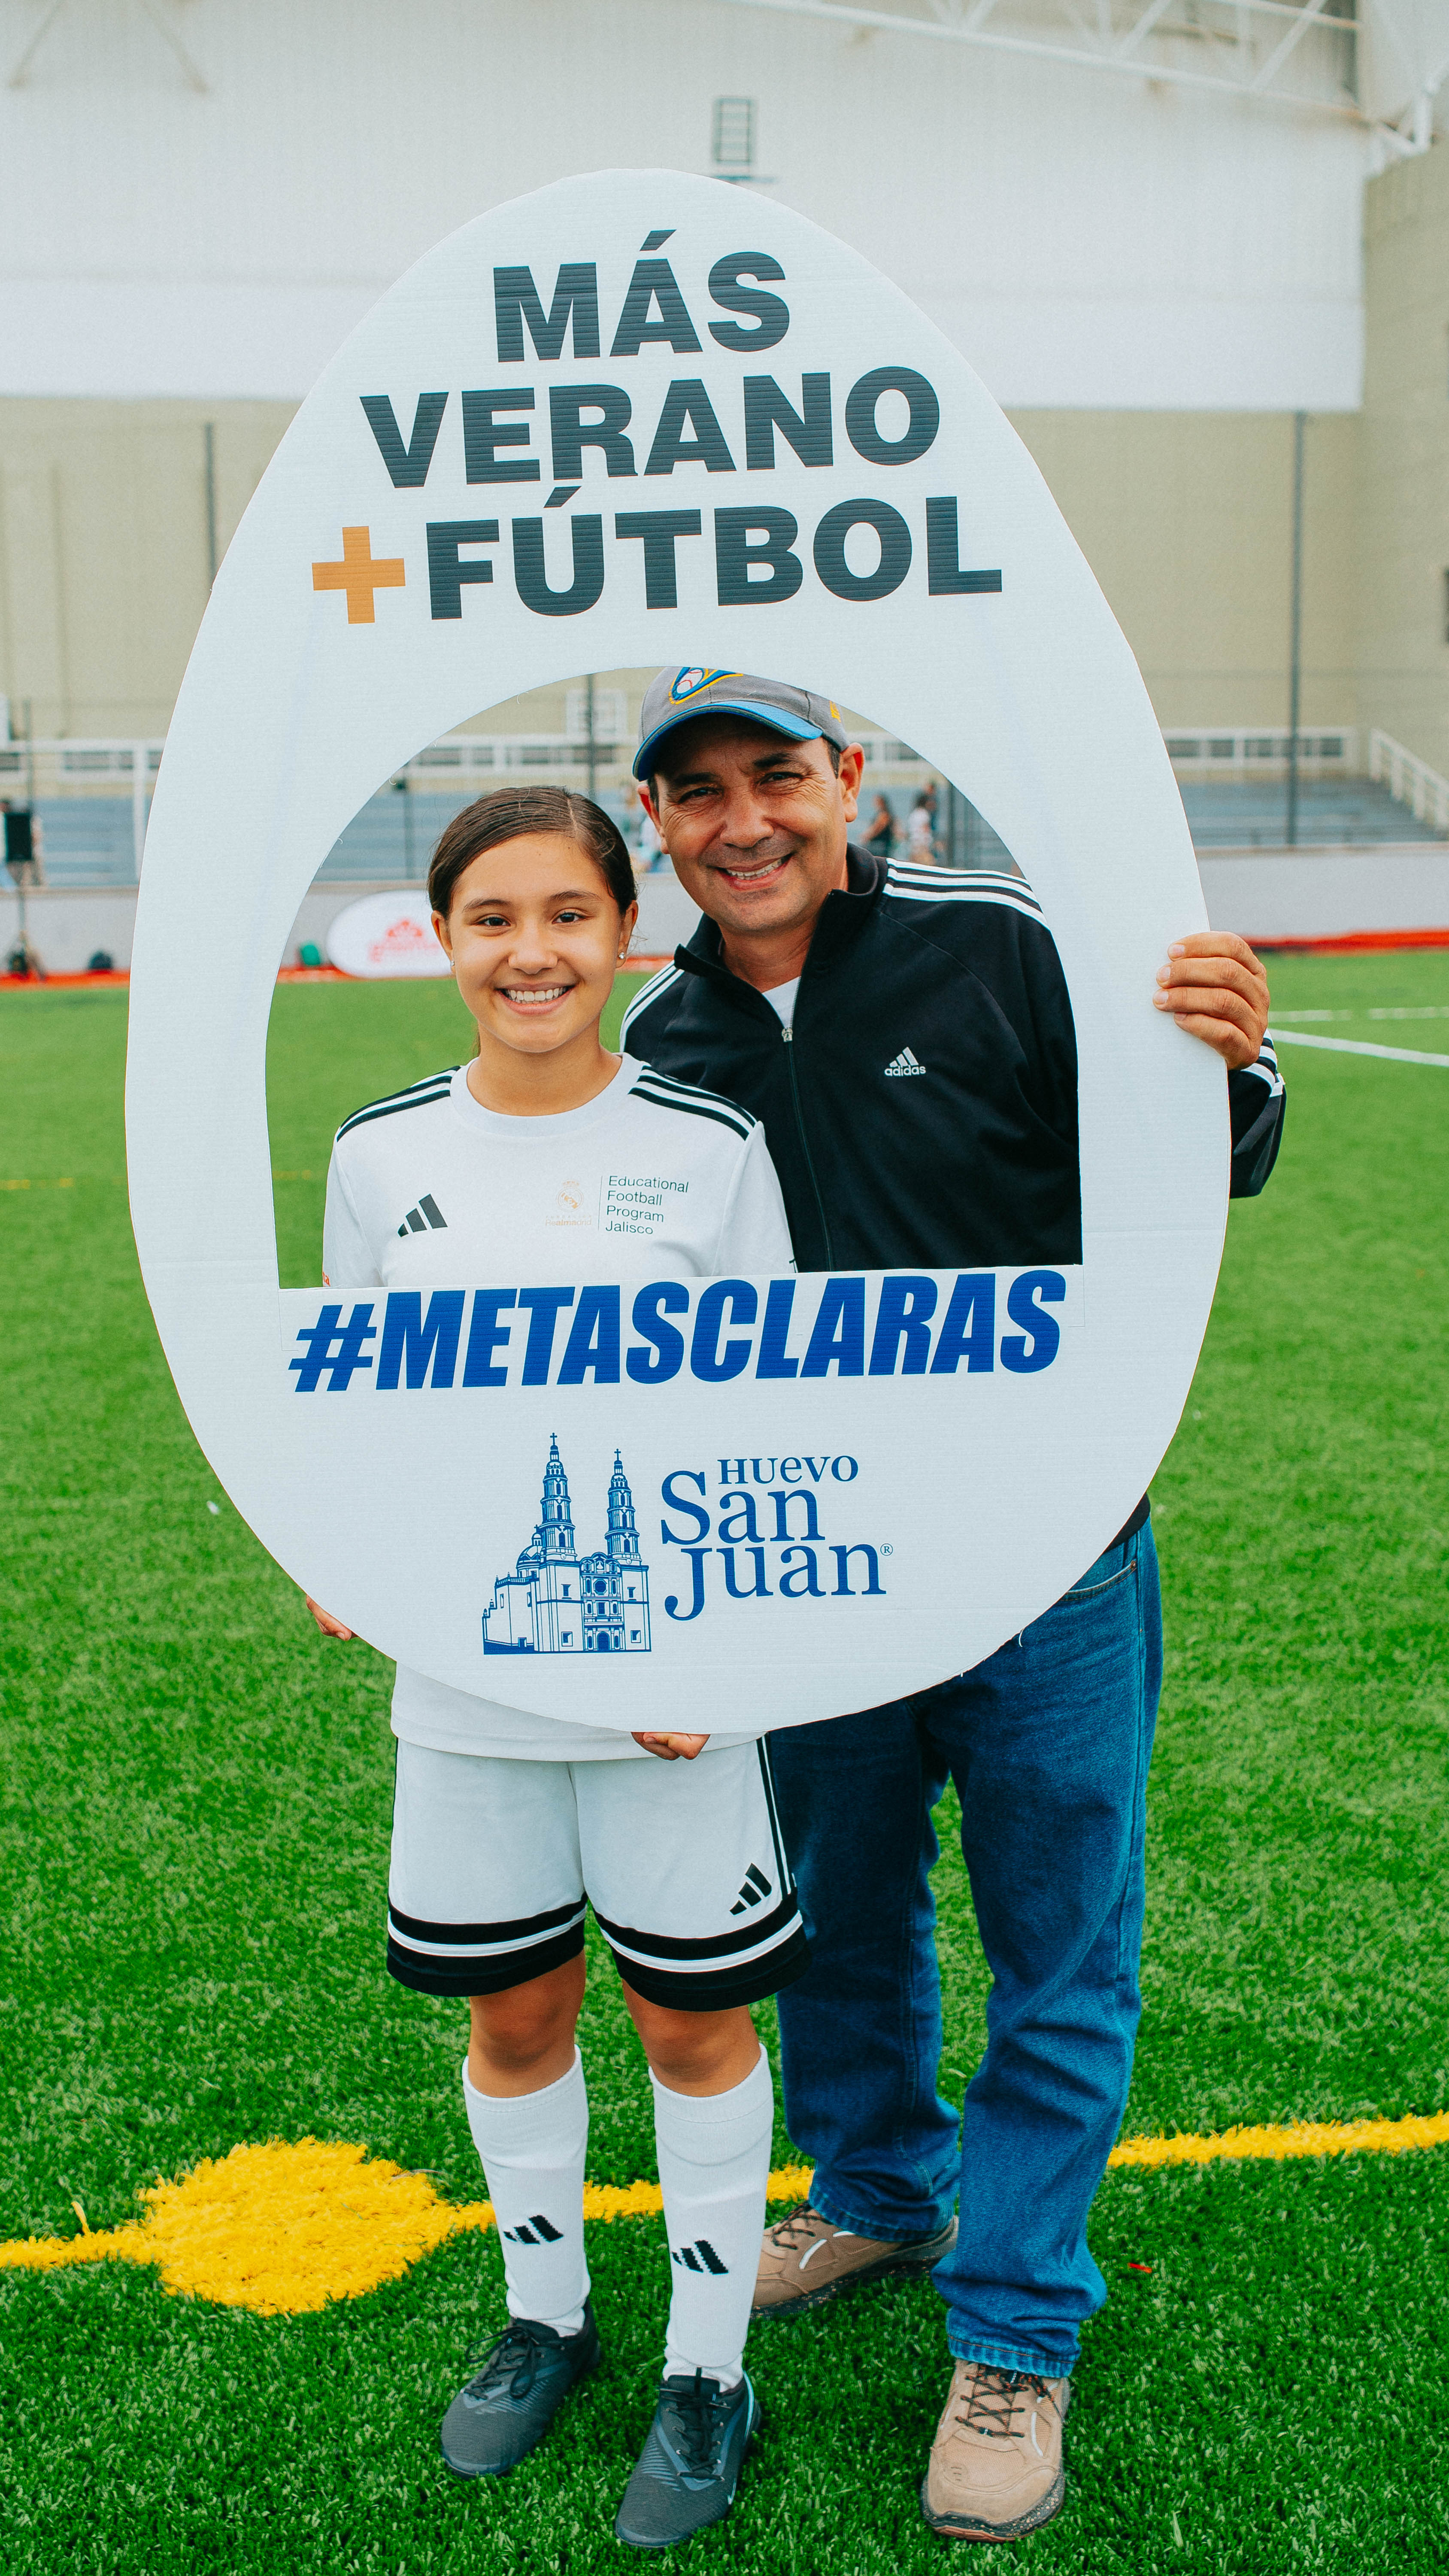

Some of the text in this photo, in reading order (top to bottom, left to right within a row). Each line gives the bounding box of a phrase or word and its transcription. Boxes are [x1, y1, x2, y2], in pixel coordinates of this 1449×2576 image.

[493, 228, 790, 363] MÁS
[359, 365, 940, 489] VERANO
[884, 1065, 927, 1076] adidas
[609, 1175, 689, 1193] Educational
[607, 1190, 663, 1206] Football
[606, 1205, 664, 1223] Program
[605, 1220, 654, 1235] Jalisco
[287, 1269, 1067, 1393] #METASCLARAS
[660, 1470, 826, 1546] San
